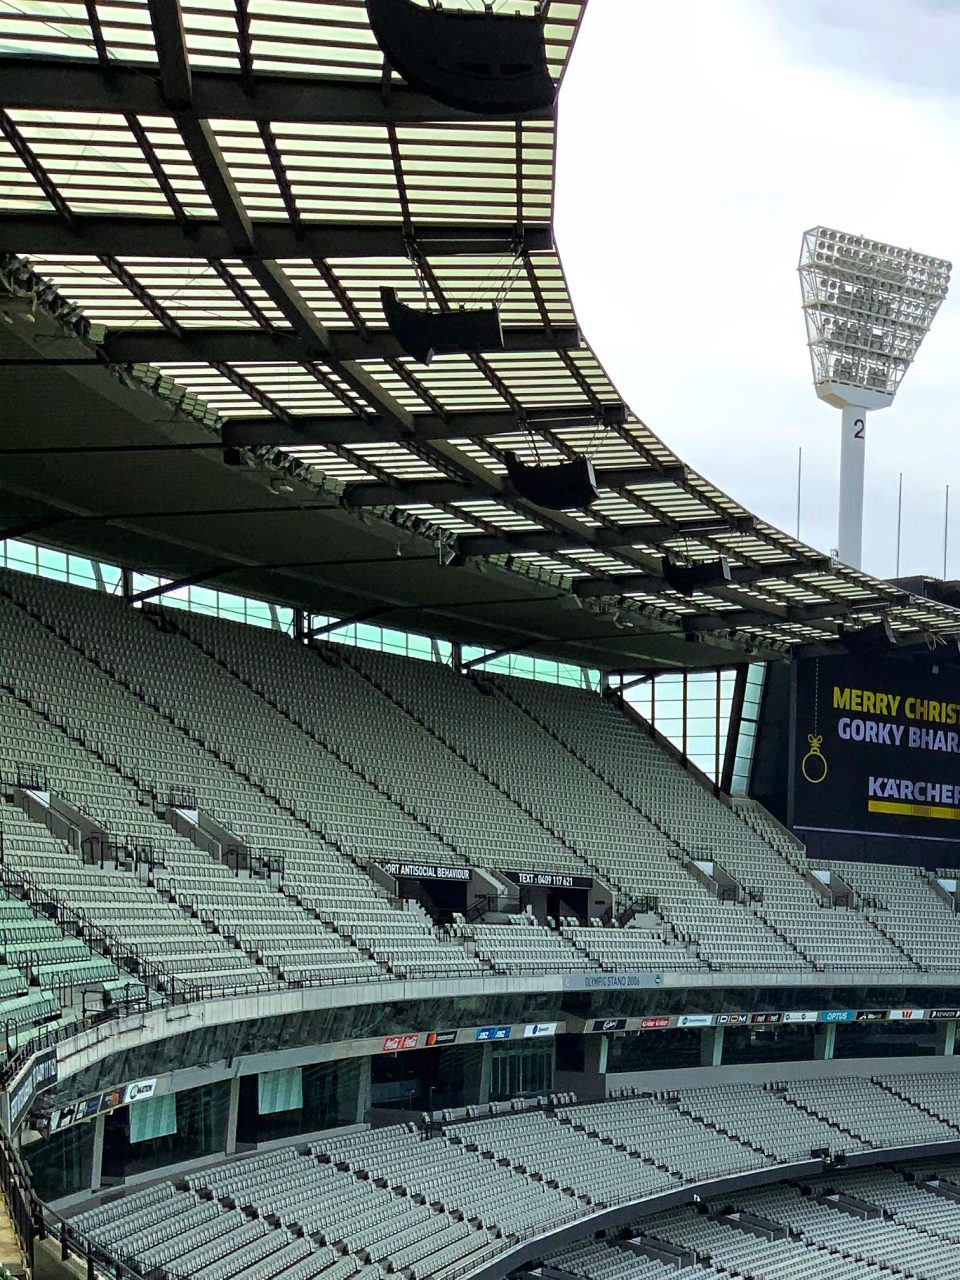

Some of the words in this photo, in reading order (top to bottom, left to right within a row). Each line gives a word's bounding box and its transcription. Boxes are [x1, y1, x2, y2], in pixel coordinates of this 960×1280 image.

[853, 418, 865, 439] 2
[833, 686, 901, 717] MERRY
[837, 717, 905, 746] GORKY
[401, 864, 436, 877] ANTISOCIAL
[437, 867, 470, 880] BEHAVIOUR
[518, 873, 534, 884] TEXT
[585, 977, 606, 987] OLYMPIC
[607, 976, 626, 986] STAND
[717, 1015, 746, 1023] IDIOM
[826, 1012, 847, 1020] OPTUS
